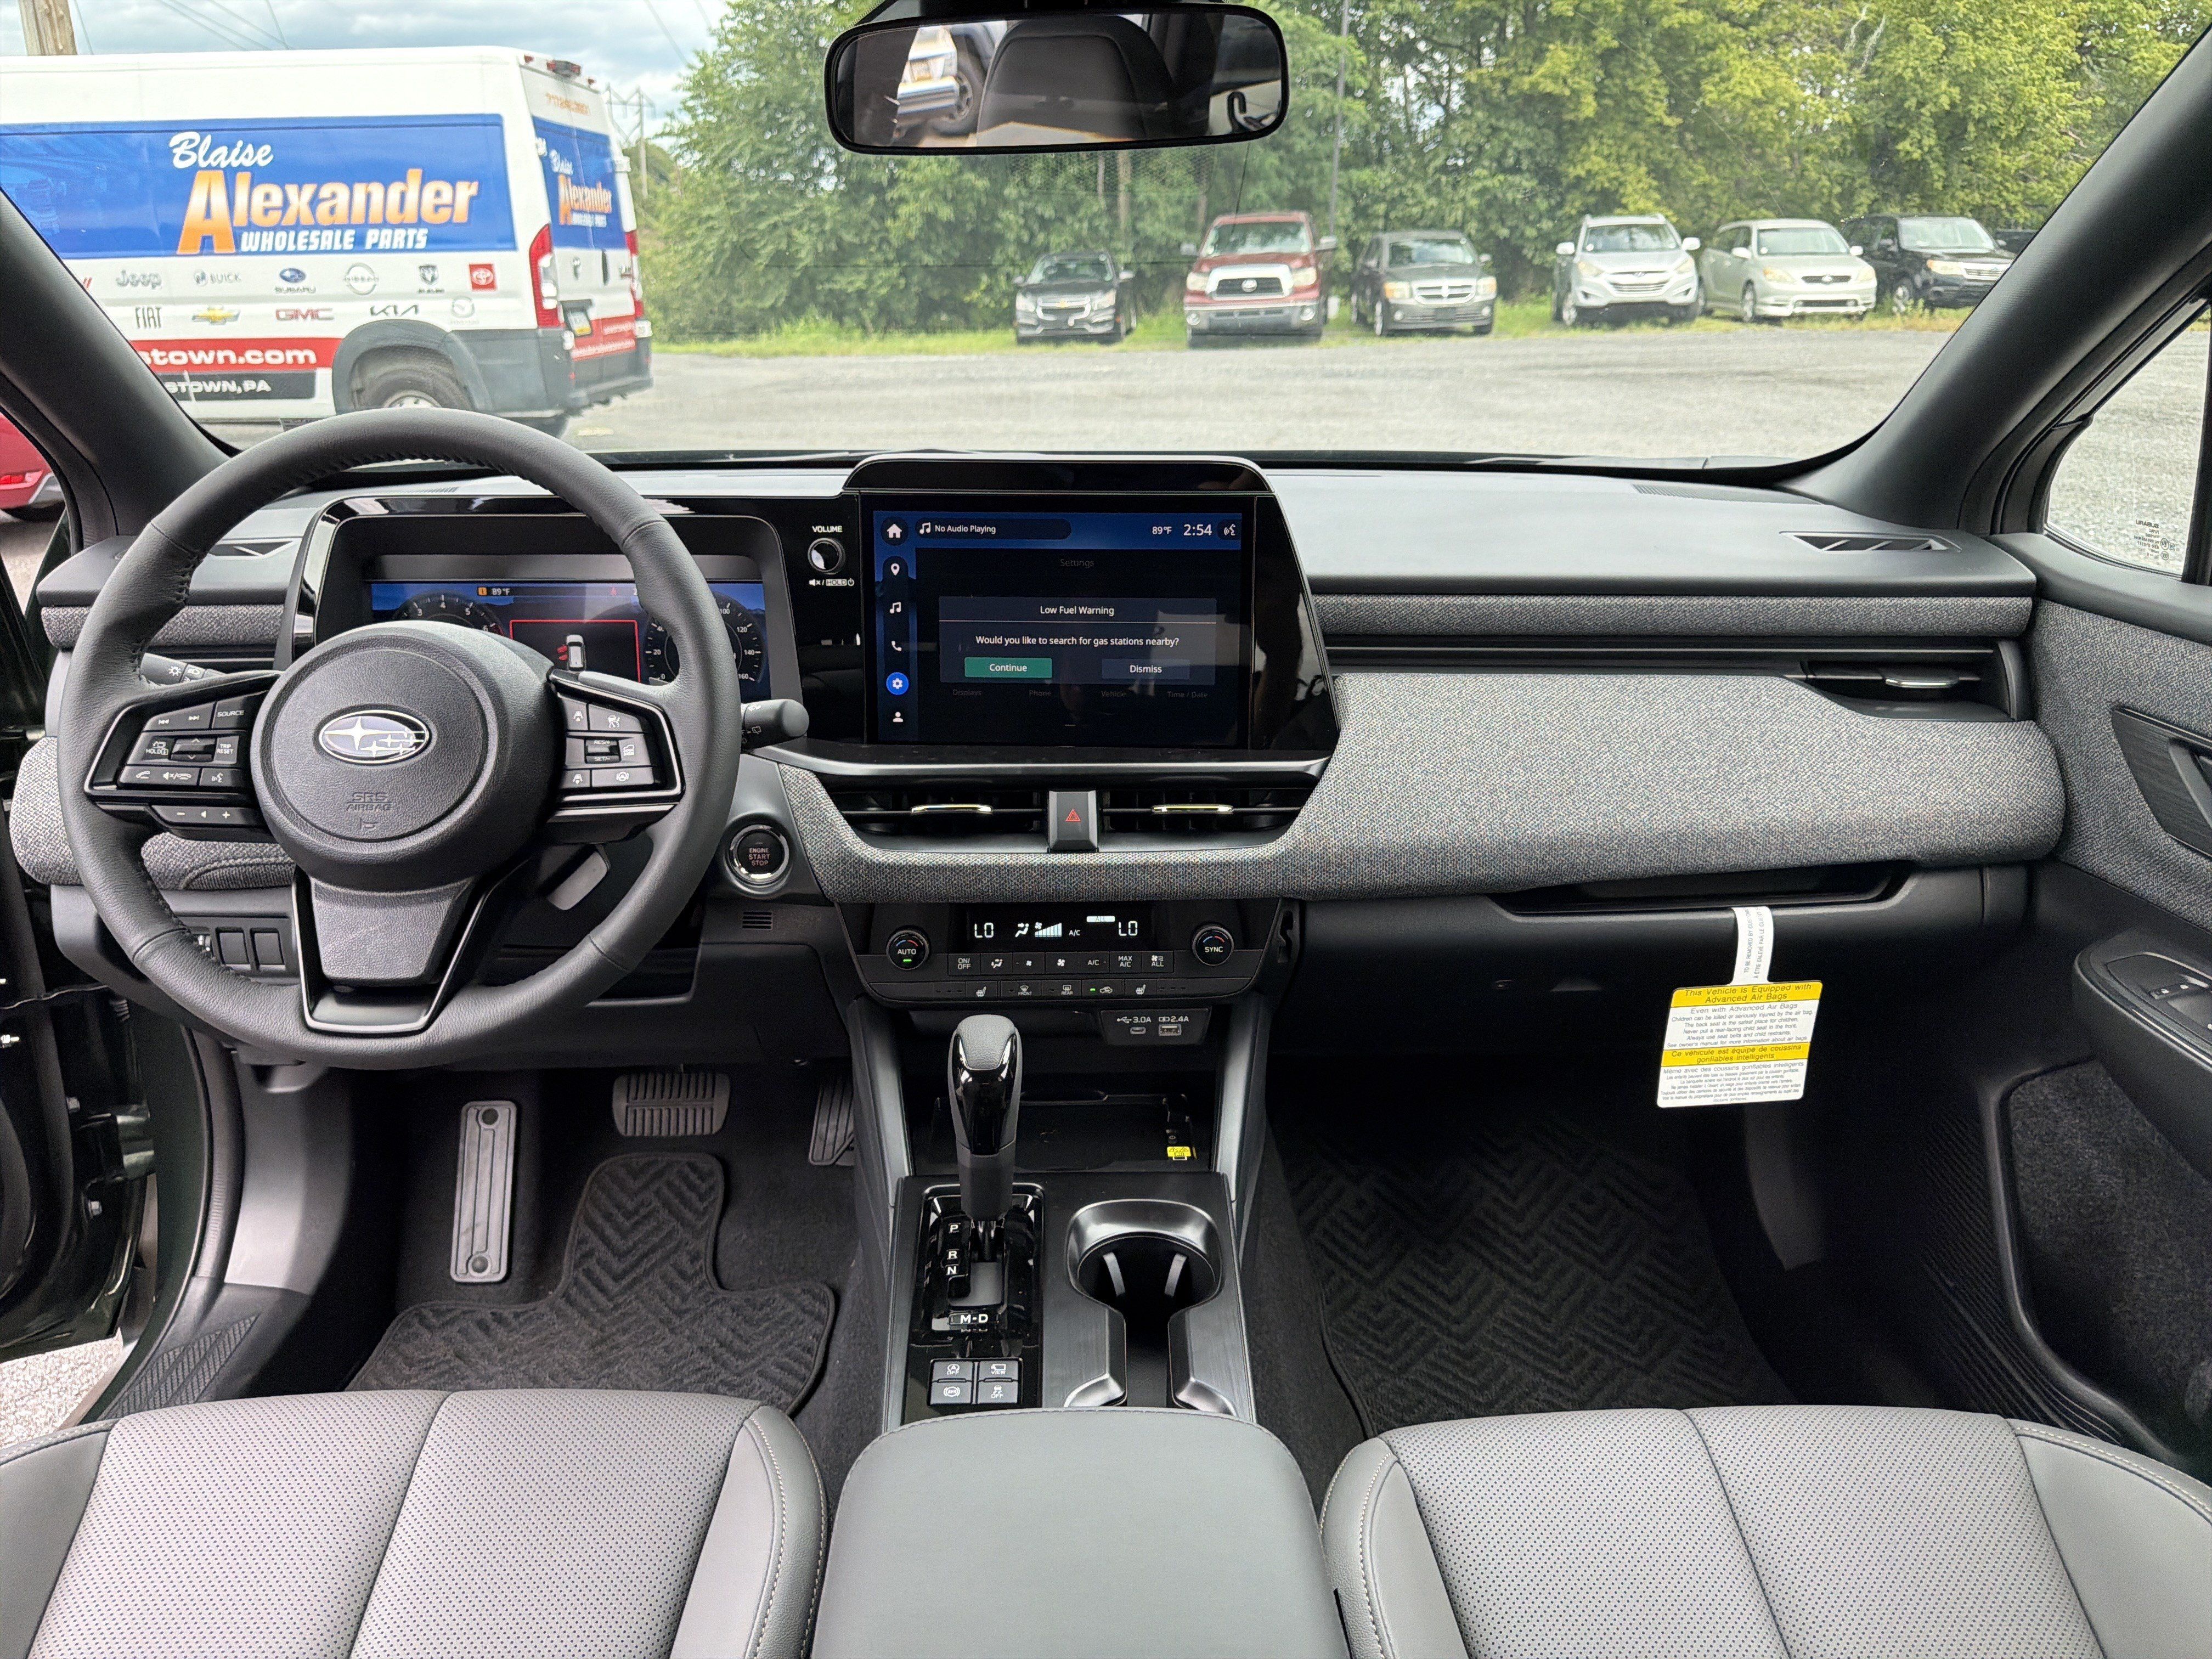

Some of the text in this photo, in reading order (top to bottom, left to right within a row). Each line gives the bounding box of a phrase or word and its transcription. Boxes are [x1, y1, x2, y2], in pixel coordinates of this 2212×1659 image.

[169, 131, 274, 168] Blaise
[558, 173, 612, 225] Alexander
[176, 168, 479, 255] Alexander
[240, 228, 428, 252] WHOLESALE PARTS
[116, 270, 162, 289] Jeep
[210, 271, 241, 285] BUICK
[274, 285, 317, 294] SUBARU
[275, 307, 335, 321] GMC
[370, 304, 420, 317] KIA
[136, 306, 162, 329] FIAT
[811, 525, 843, 533] VOLUME
[970, 524, 996, 534] Playing
[1152, 526, 1172, 534] 89°F
[1183, 523, 1212, 536] 2:54
[1060, 558, 1094, 568] Settings
[417, 608, 423, 617] 3
[465, 607, 471, 616] 5
[1040, 606, 1115, 617] Low Fuel Warning
[975, 635, 1002, 644] Would
[1005, 637, 1020, 646] you
[1022, 636, 1037, 644] like
[1049, 636, 1077, 645] search
[1079, 636, 1092, 645] for
[1093, 638, 1108, 647] gas
[1110, 637, 1144, 645] stations
[1146, 637, 1180, 648] nearby?
[989, 663, 1028, 672] Continue
[1130, 664, 1163, 673] Dismiss
[952, 689, 983, 697] Displays
[352, 792, 389, 801] SRS
[346, 803, 392, 811] AIRBAG
[974, 922, 994, 938] LO
[1118, 921, 1138, 936] LO
[1752, 985, 1791, 994] Equipped
[1705, 994, 1748, 1003] Advanced
[1685, 1048, 1715, 1057] véhicule
[1696, 1056, 1734, 1064] gonflables
[950, 1224, 959, 1232] P
[948, 1250, 957, 1259] R
[947, 1266, 956, 1274] N
